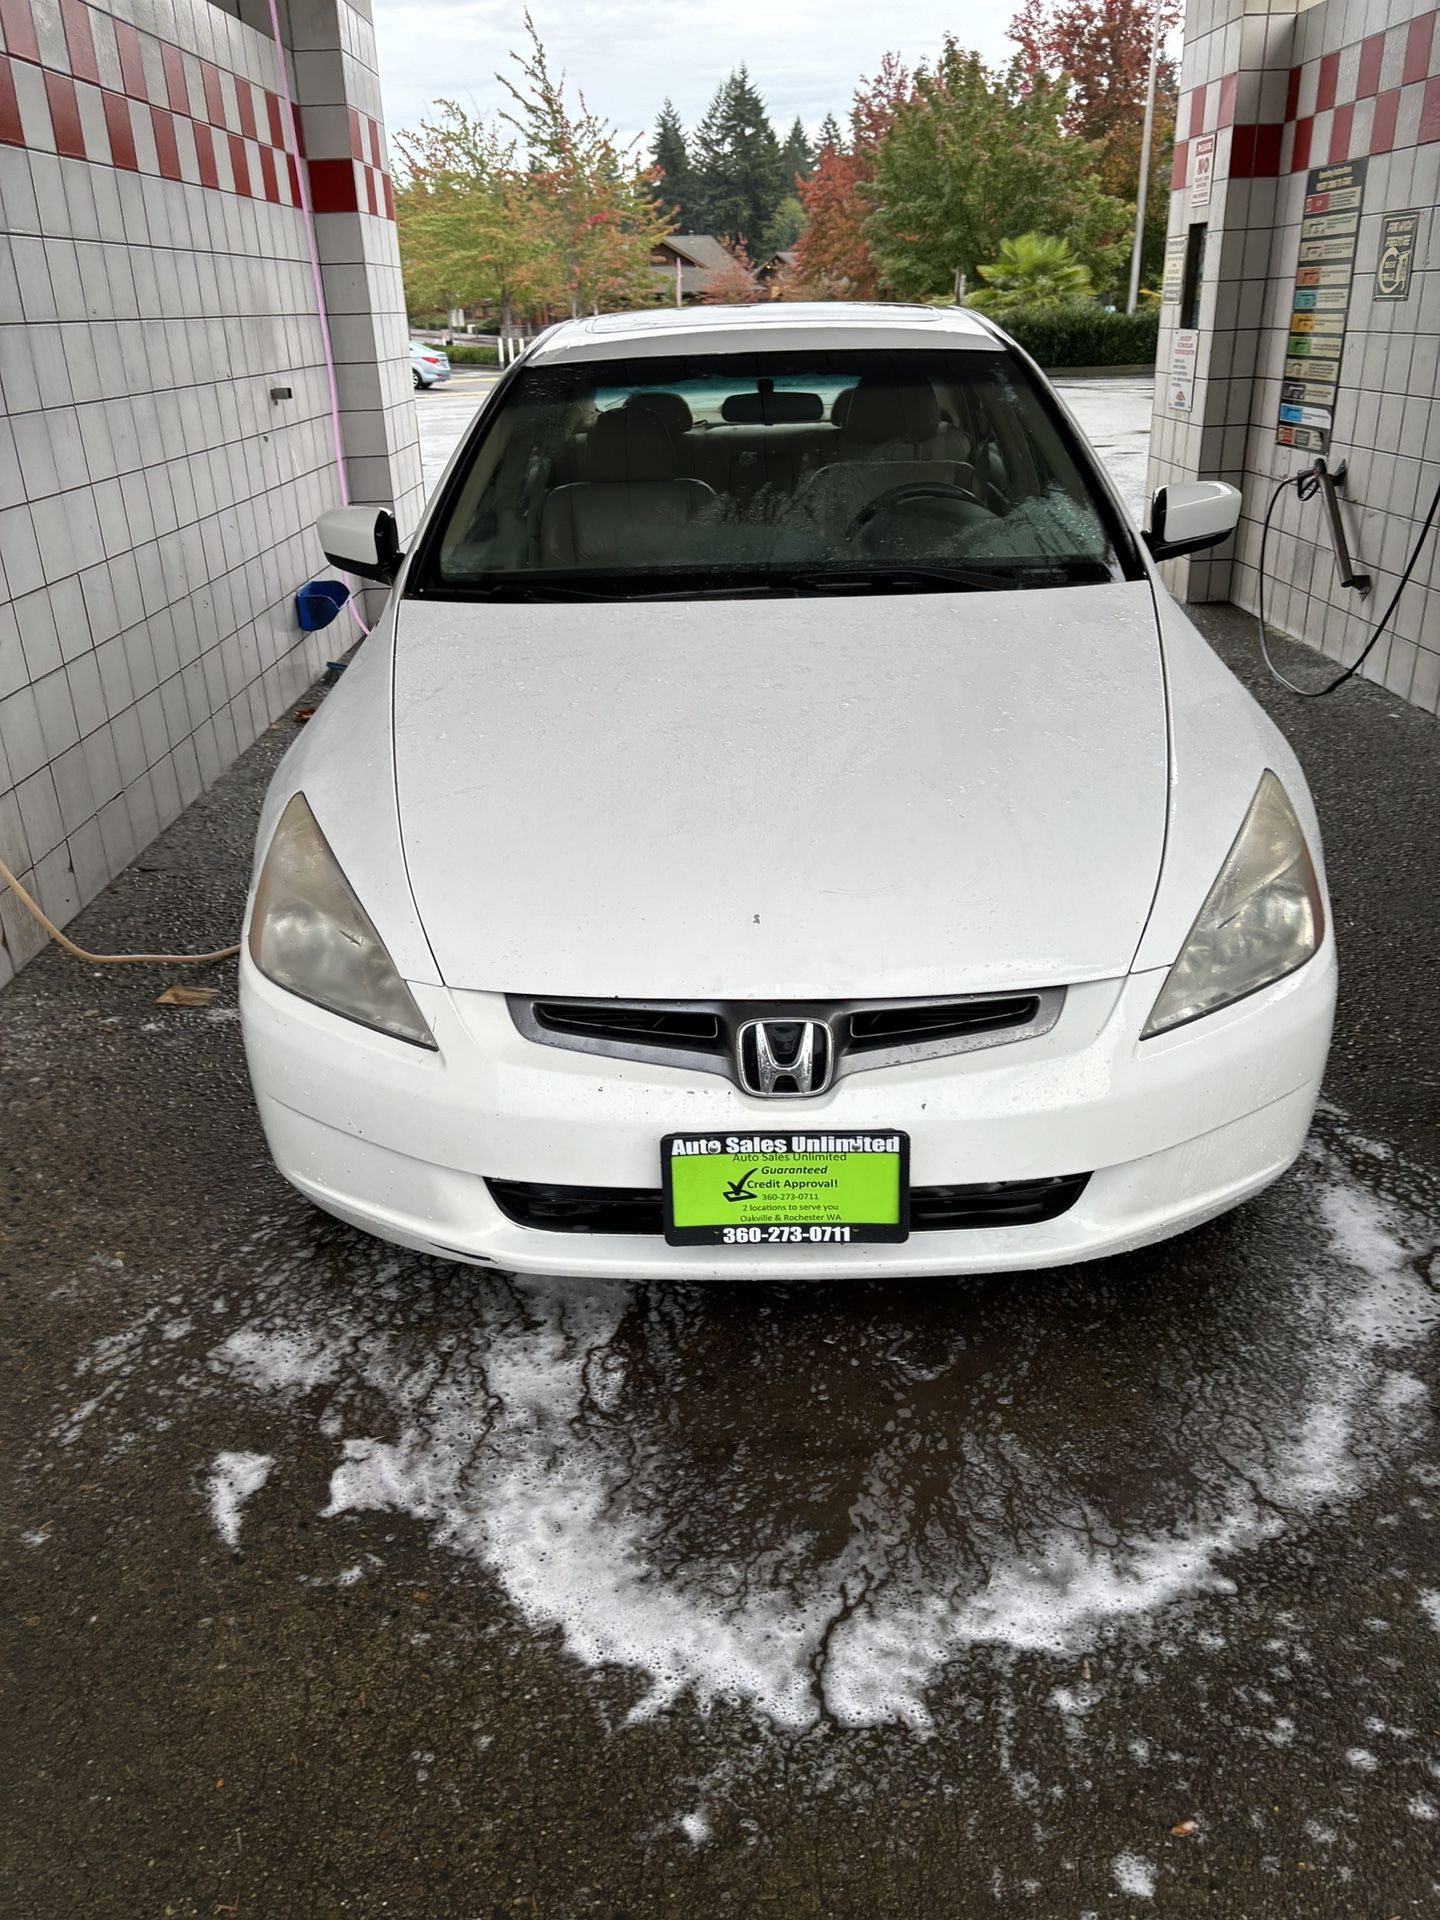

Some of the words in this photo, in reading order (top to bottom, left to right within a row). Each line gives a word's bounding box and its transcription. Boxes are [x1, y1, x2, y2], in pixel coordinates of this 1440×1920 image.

[672, 1139, 721, 1155] Auto
[726, 1137, 787, 1153] Sales
[792, 1136, 899, 1152] Unlimited
[733, 1153, 759, 1162] Auto
[762, 1153, 789, 1161] Sales
[762, 1166, 828, 1174] Guaranteed
[747, 1180, 780, 1188] Credit
[784, 1179, 838, 1189] Approval!
[740, 1214, 772, 1222] Oakville
[723, 1226, 850, 1243] 360-273-0711
